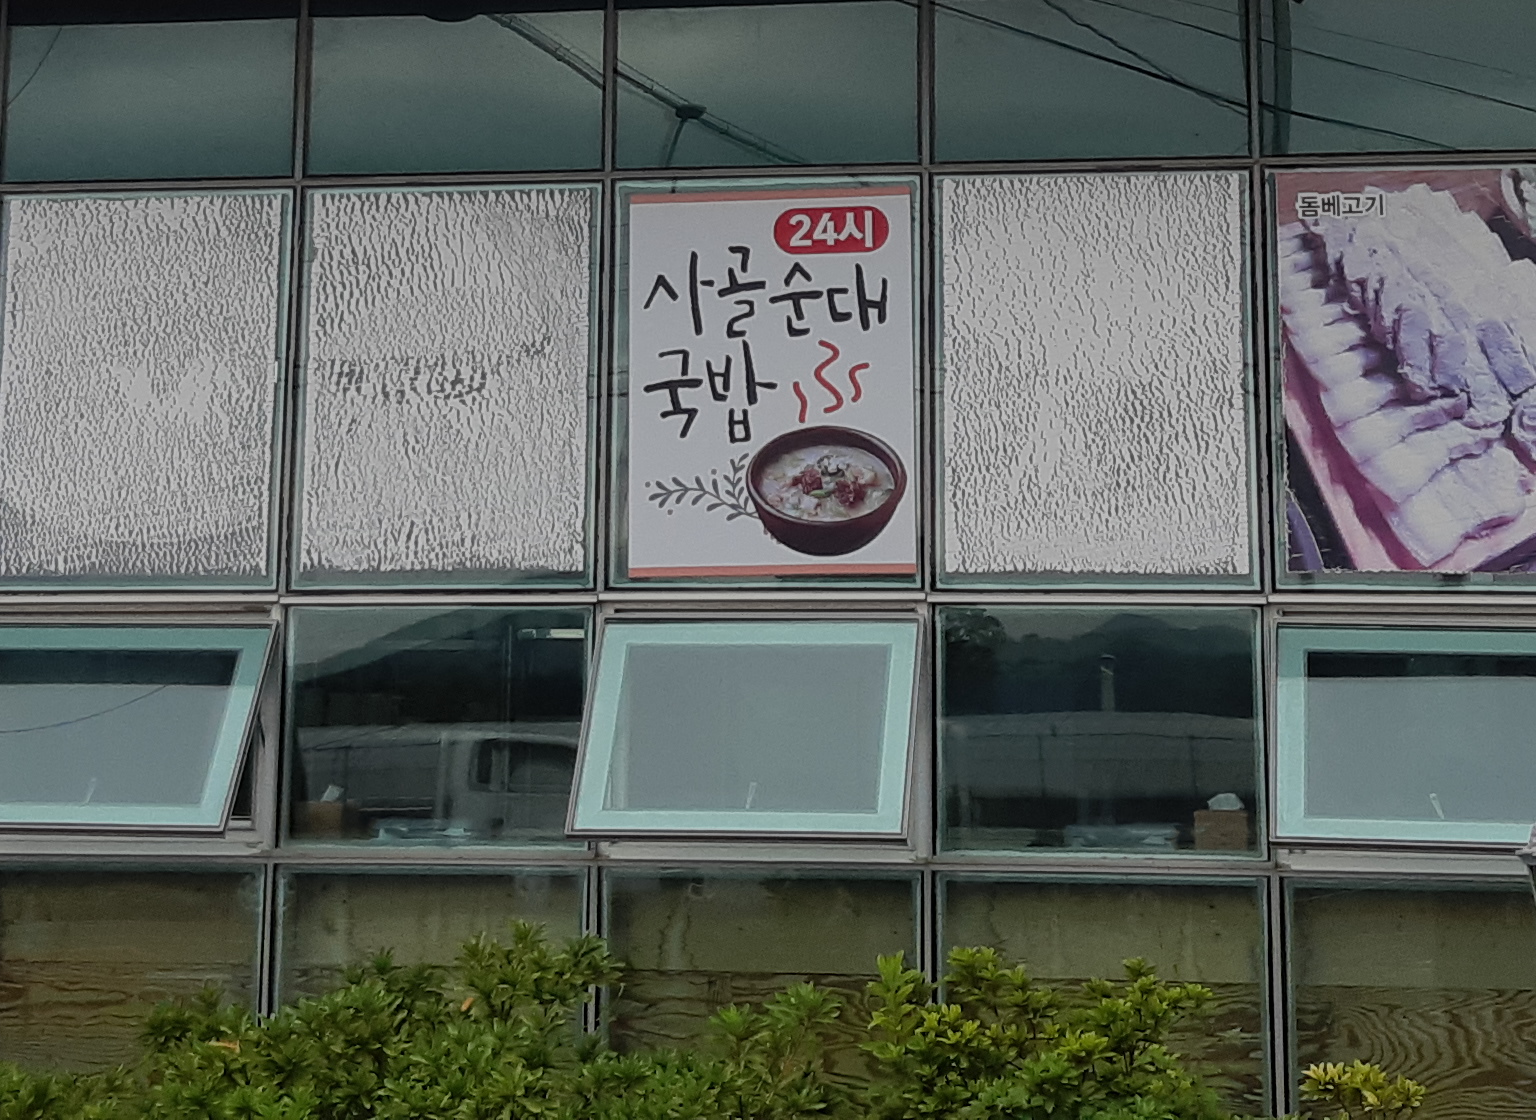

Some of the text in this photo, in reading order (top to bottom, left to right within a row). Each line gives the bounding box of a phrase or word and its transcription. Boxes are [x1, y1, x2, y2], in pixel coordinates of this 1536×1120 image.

[788, 209, 875, 249] 24시
[1297, 193, 1386, 218] 돔베고기
[643, 245, 888, 338] 사골순대
[643, 339, 778, 443] 국밥
